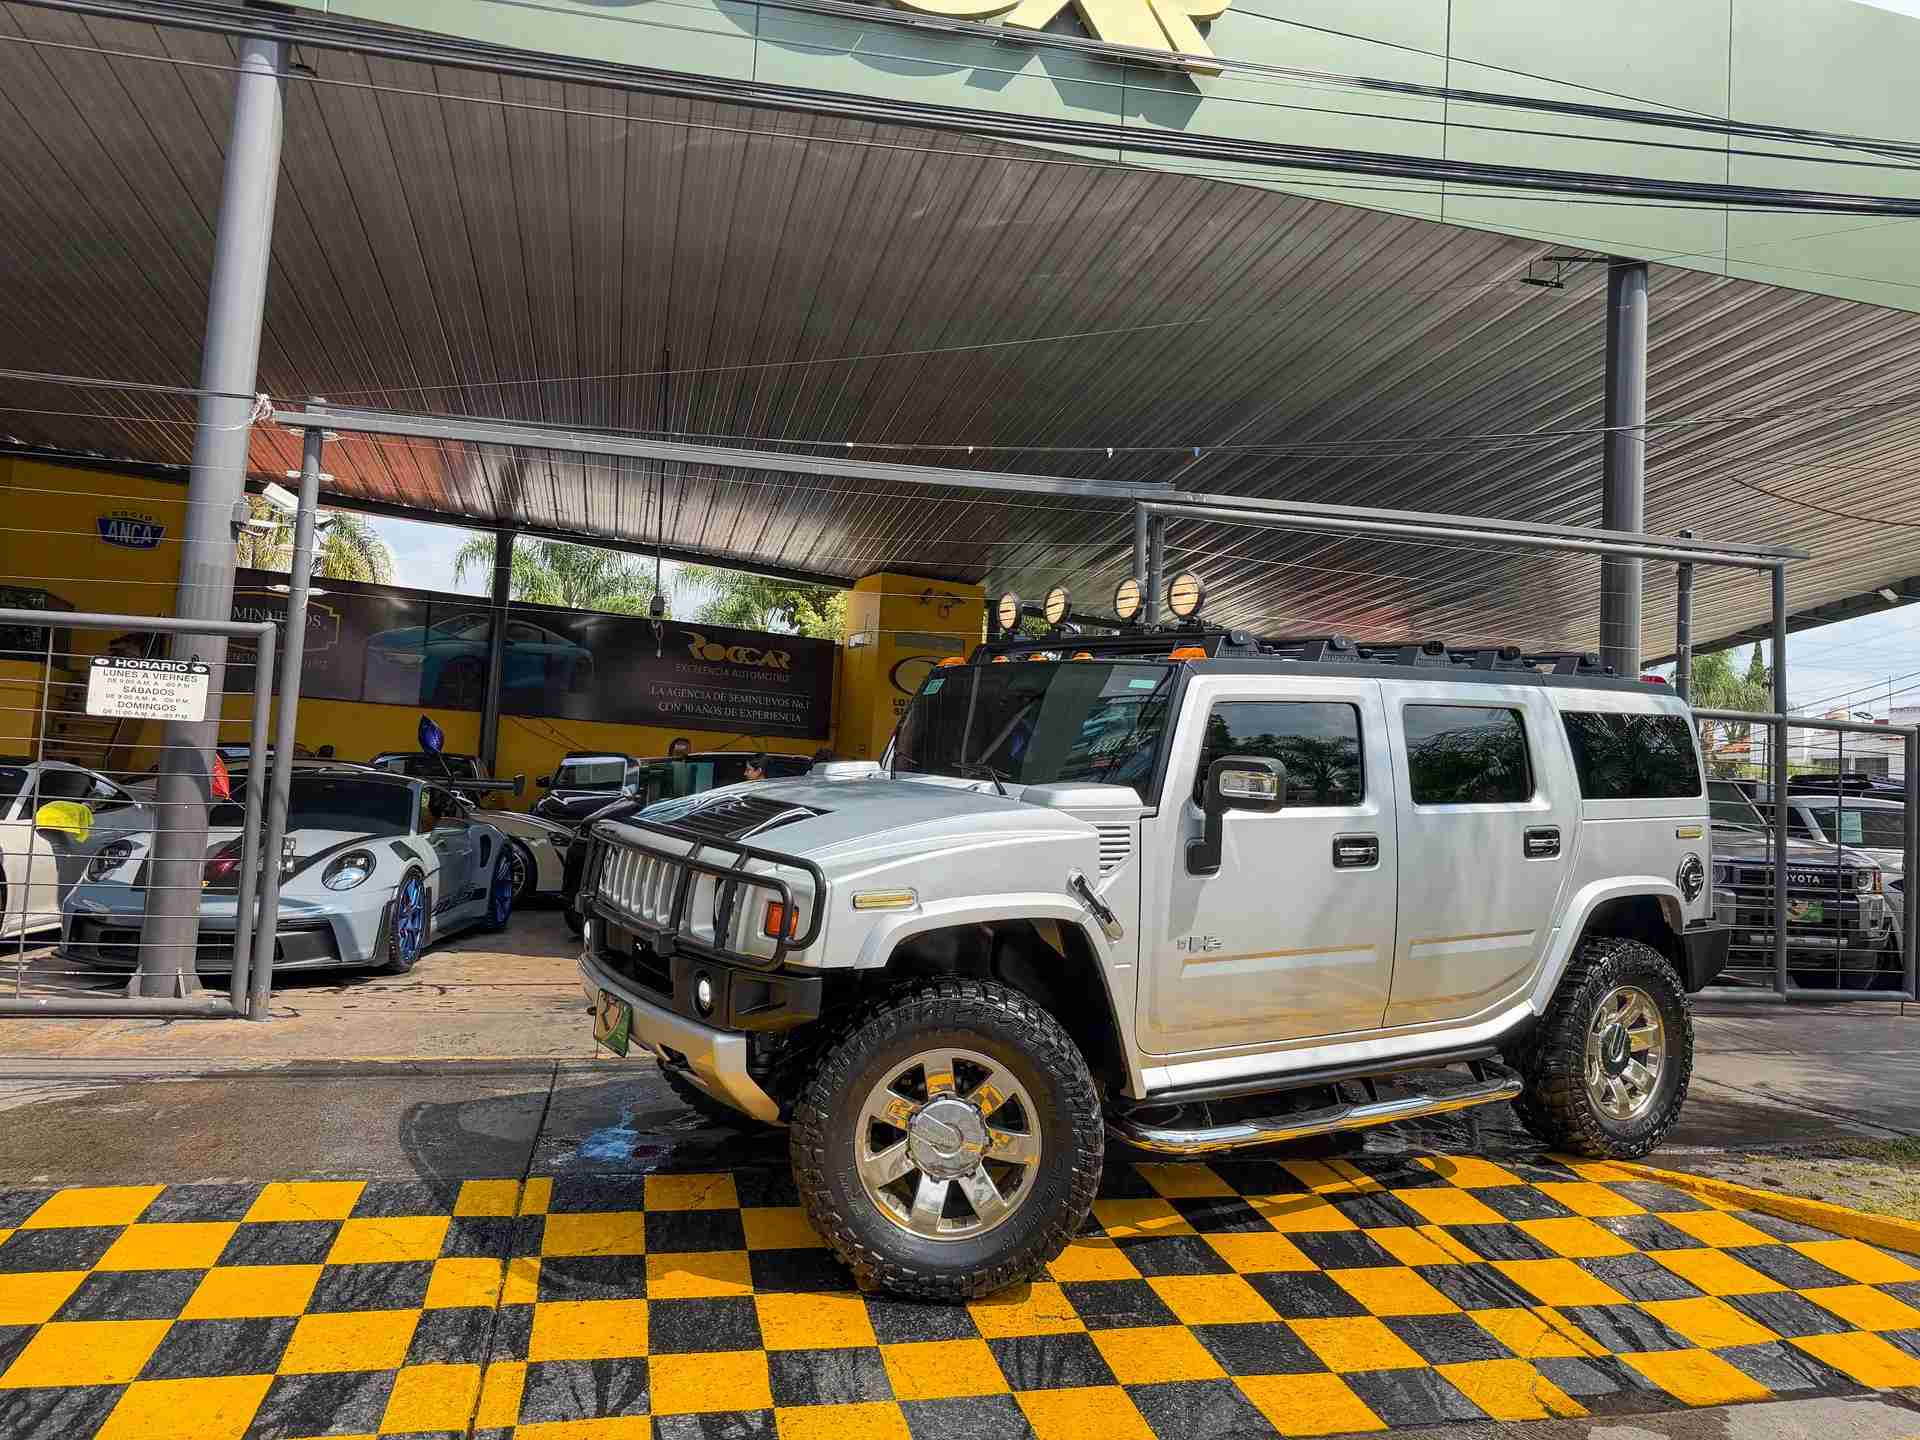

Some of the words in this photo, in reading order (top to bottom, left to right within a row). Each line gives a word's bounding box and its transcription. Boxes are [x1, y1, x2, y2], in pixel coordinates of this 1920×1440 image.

[107, 521, 152, 544] ANCA
[680, 630, 792, 670] ROCCAR
[115, 659, 189, 672] HORARIO
[103, 669, 138, 679] LUNES
[153, 673, 198, 683] VIERNES
[123, 685, 175, 696] SABADOS
[651, 685, 664, 697] LA
[666, 687, 711, 700] AGENCIA
[713, 690, 727, 702] DE
[729, 693, 790, 707] SEMINUEVOS
[117, 701, 177, 711] DOMINGOS
[658, 702, 680, 712] CON
[695, 703, 722, 716] AÑOS
[724, 706, 737, 717] DE
[739, 708, 801, 723] EXPERIENCIA
